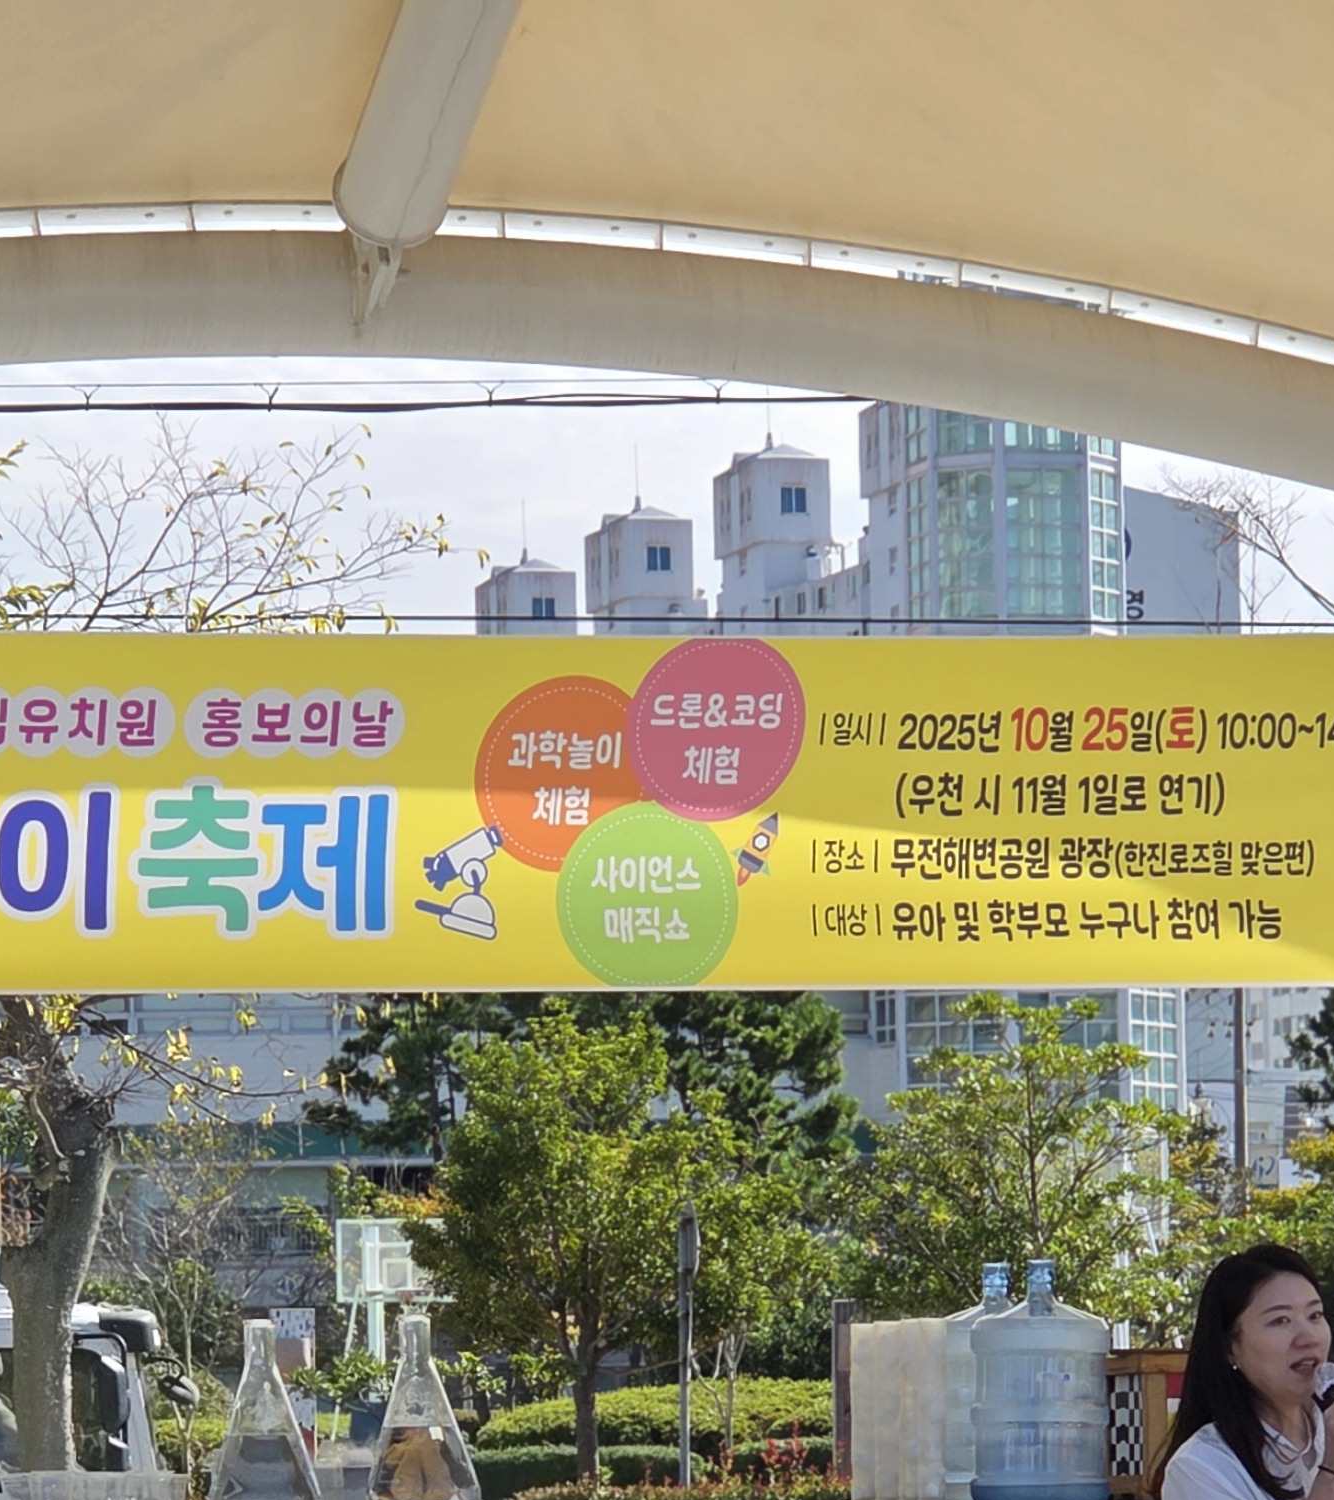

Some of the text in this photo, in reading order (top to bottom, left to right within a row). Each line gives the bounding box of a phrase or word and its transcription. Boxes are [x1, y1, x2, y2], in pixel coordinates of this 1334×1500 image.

[202, 697, 395, 749] 홍보의날
[650, 693, 783, 730] 드론&코딩
[897, 710, 1002, 753] 2025년
[1011, 706, 1075, 752] 10월
[1081, 706, 1208, 755] 25일(토)
[507, 731, 622, 770] 과학놀이
[682, 747, 741, 786] 체험
[532, 787, 591, 826] 체험
[895, 772, 1226, 819] (우천 시 11월 1일로 연기)
[590, 855, 702, 894] 사이언스
[891, 837, 1050, 880] 무전해변공원
[1240, 839, 1315, 877] 맞은편)
[604, 907, 690, 943] 매직쇼
[892, 902, 946, 942] 유아
[953, 902, 981, 942] 및
[987, 900, 1070, 941] 학부모
[1079, 901, 1161, 940] 누구나
[1166, 898, 1221, 941] 참여
[1228, 899, 1283, 940] 가능
